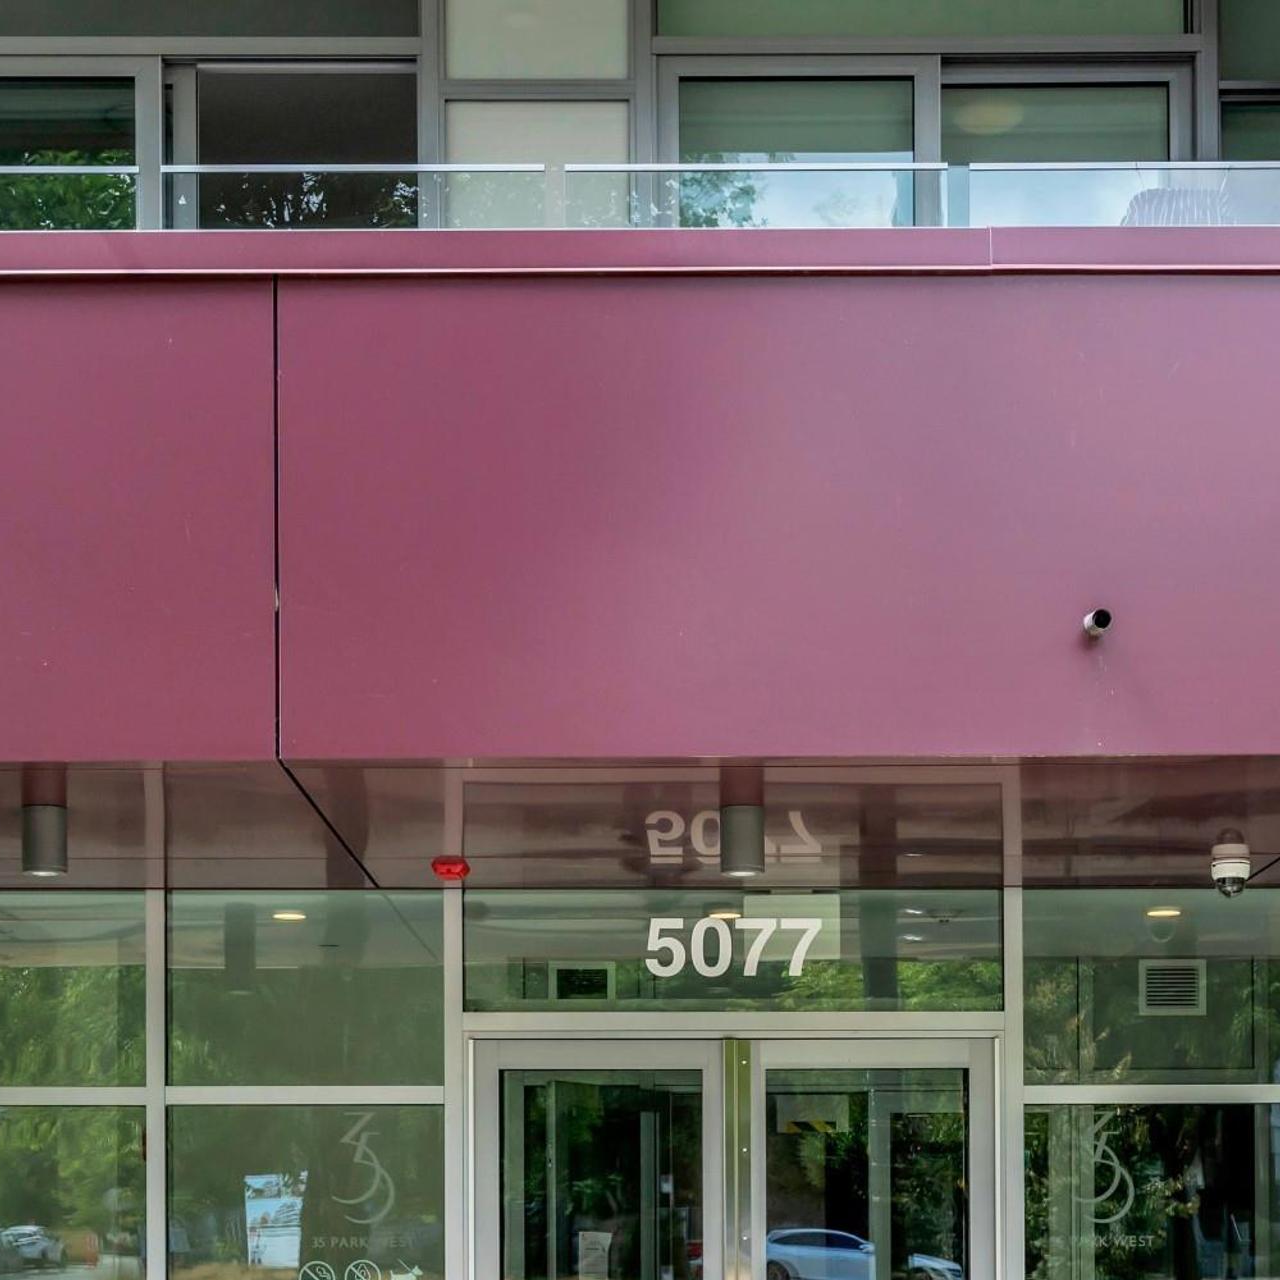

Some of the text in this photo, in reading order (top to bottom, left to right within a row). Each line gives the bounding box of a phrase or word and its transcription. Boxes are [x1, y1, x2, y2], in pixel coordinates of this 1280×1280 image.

[645, 918, 823, 977] 5077
[312, 1236, 326, 1248] 35
[330, 1236, 369, 1248] PARK
[1113, 1235, 1154, 1247] WEST
